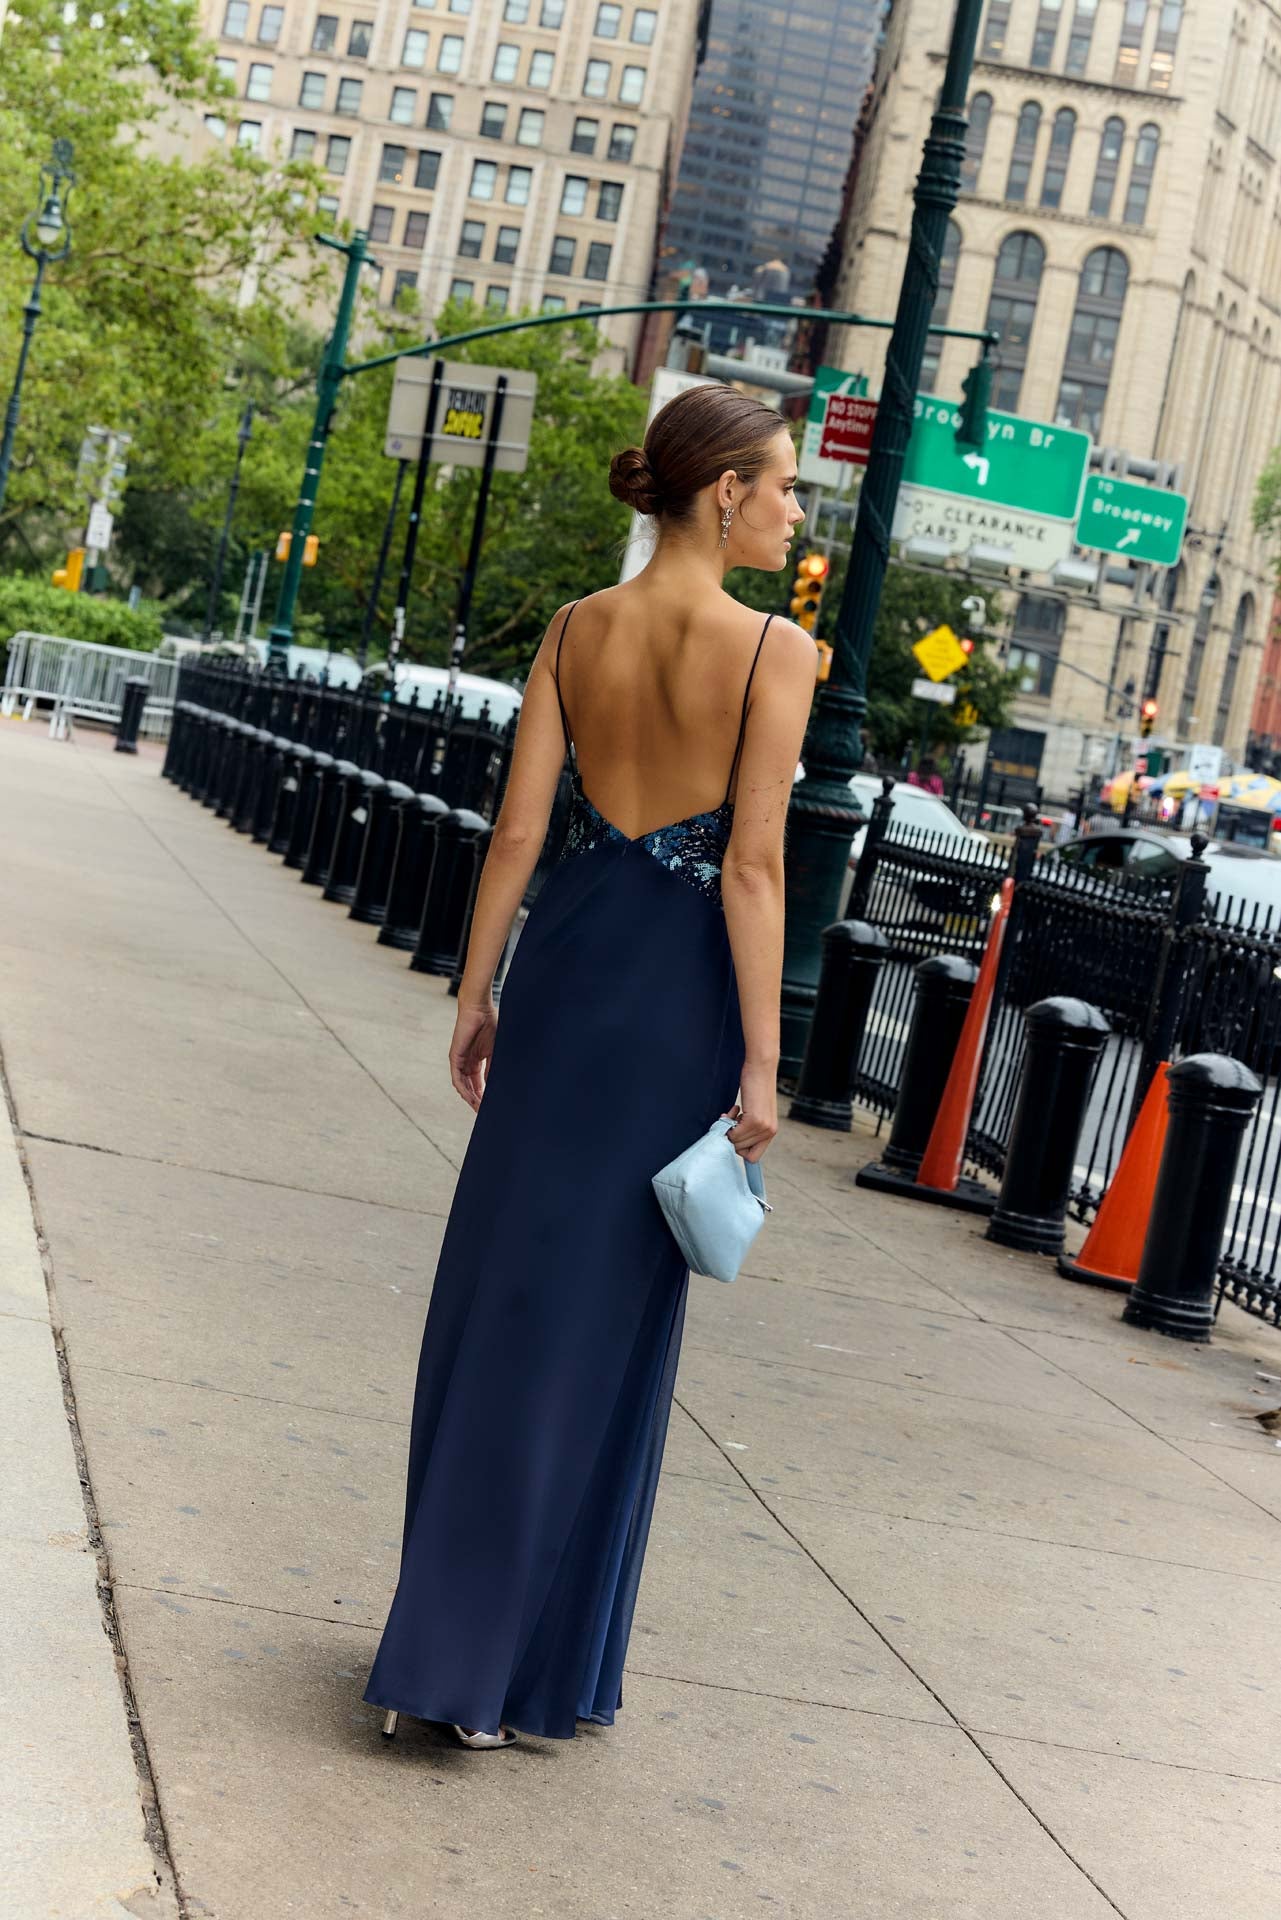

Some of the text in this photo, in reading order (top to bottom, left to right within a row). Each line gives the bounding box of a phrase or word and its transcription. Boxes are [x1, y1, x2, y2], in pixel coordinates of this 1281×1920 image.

[830, 399, 846, 416] NO
[829, 414, 870, 435] Anytime
[913, 399, 1056, 449] Brooyn Br
[943, 505, 1048, 542] CLEARANCE
[1091, 498, 1173, 533] Broadway
[912, 519, 957, 545] CARS
